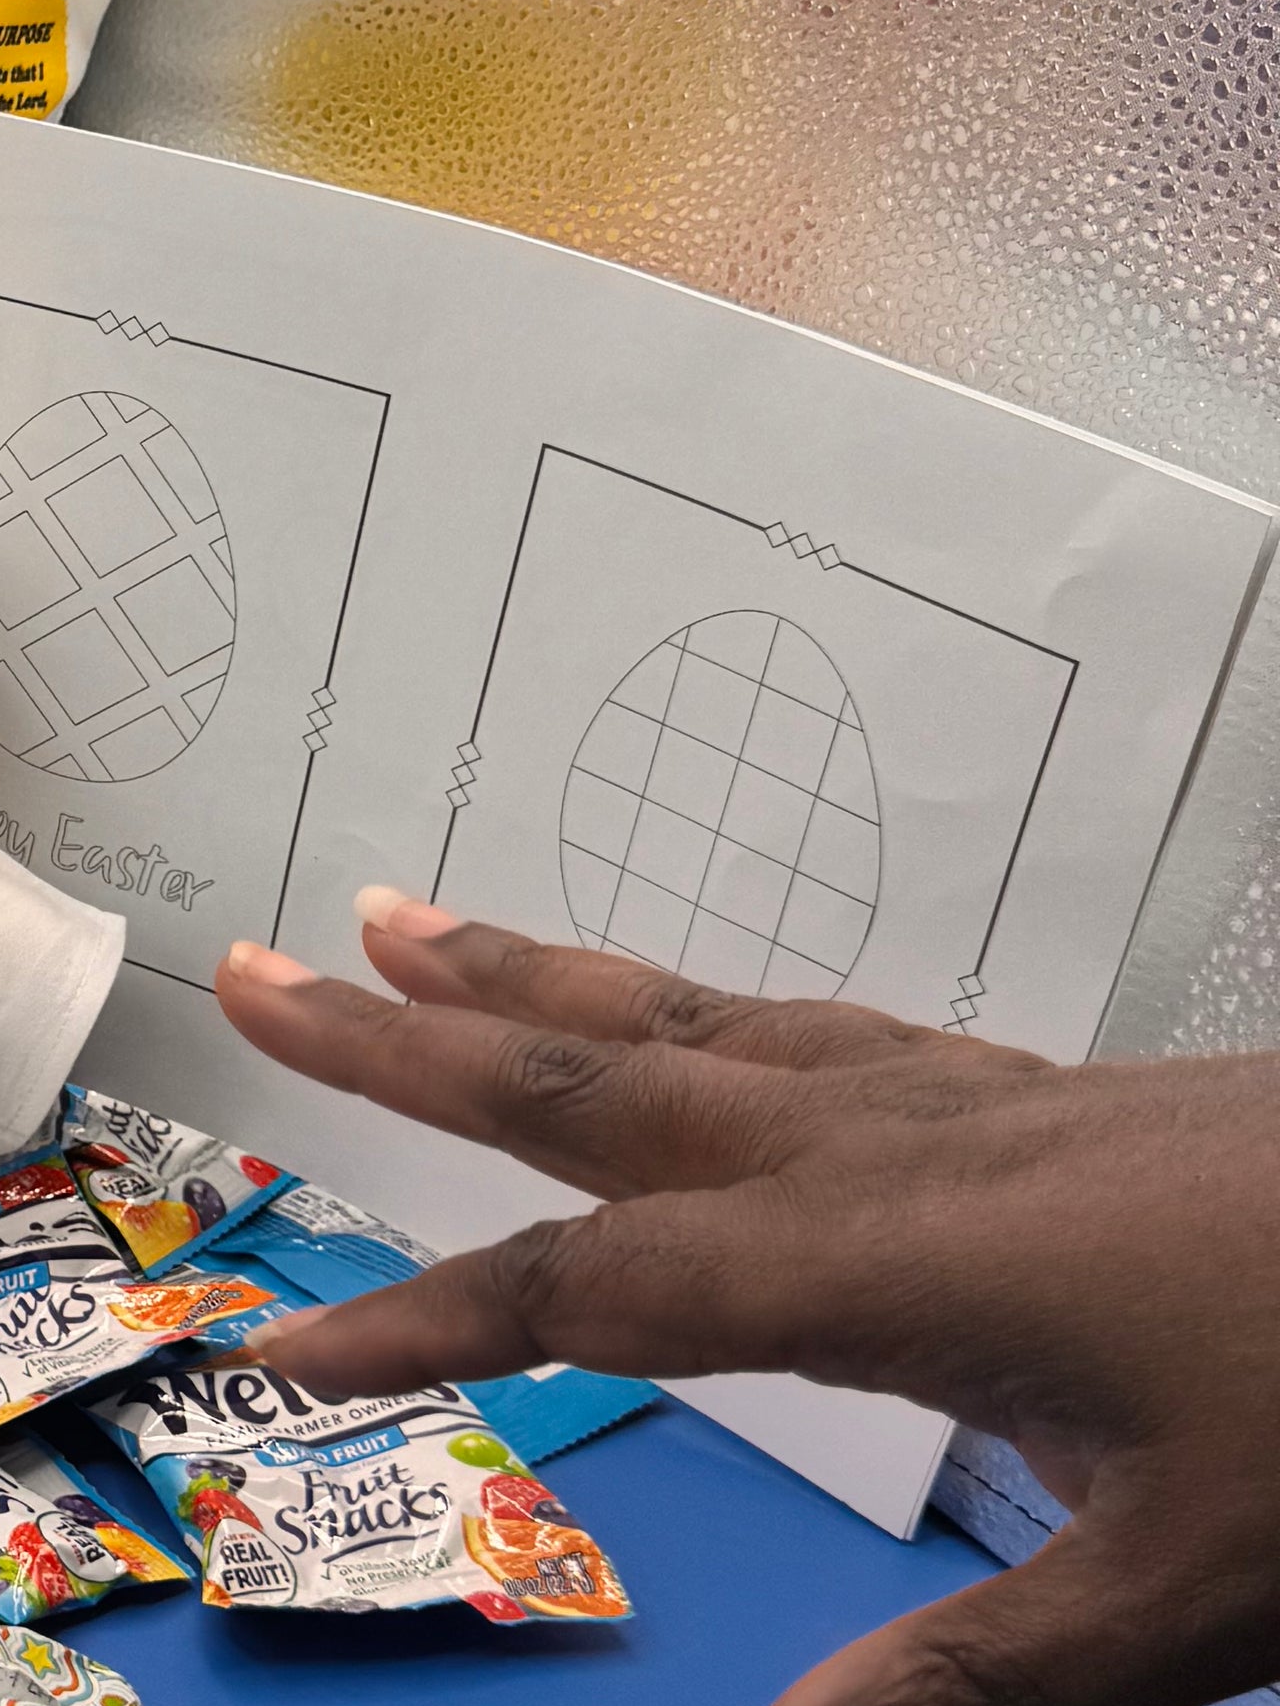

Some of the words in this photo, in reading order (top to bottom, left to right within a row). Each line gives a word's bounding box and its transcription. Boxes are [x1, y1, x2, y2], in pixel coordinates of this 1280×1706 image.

[50, 813, 214, 912] Easter
[333, 1433, 390, 1465] FRUIT
[299, 1462, 415, 1513] Fruit
[274, 1482, 449, 1556] Snacks
[220, 1540, 273, 1565] REAL
[221, 1563, 291, 1592] FRUIT!
